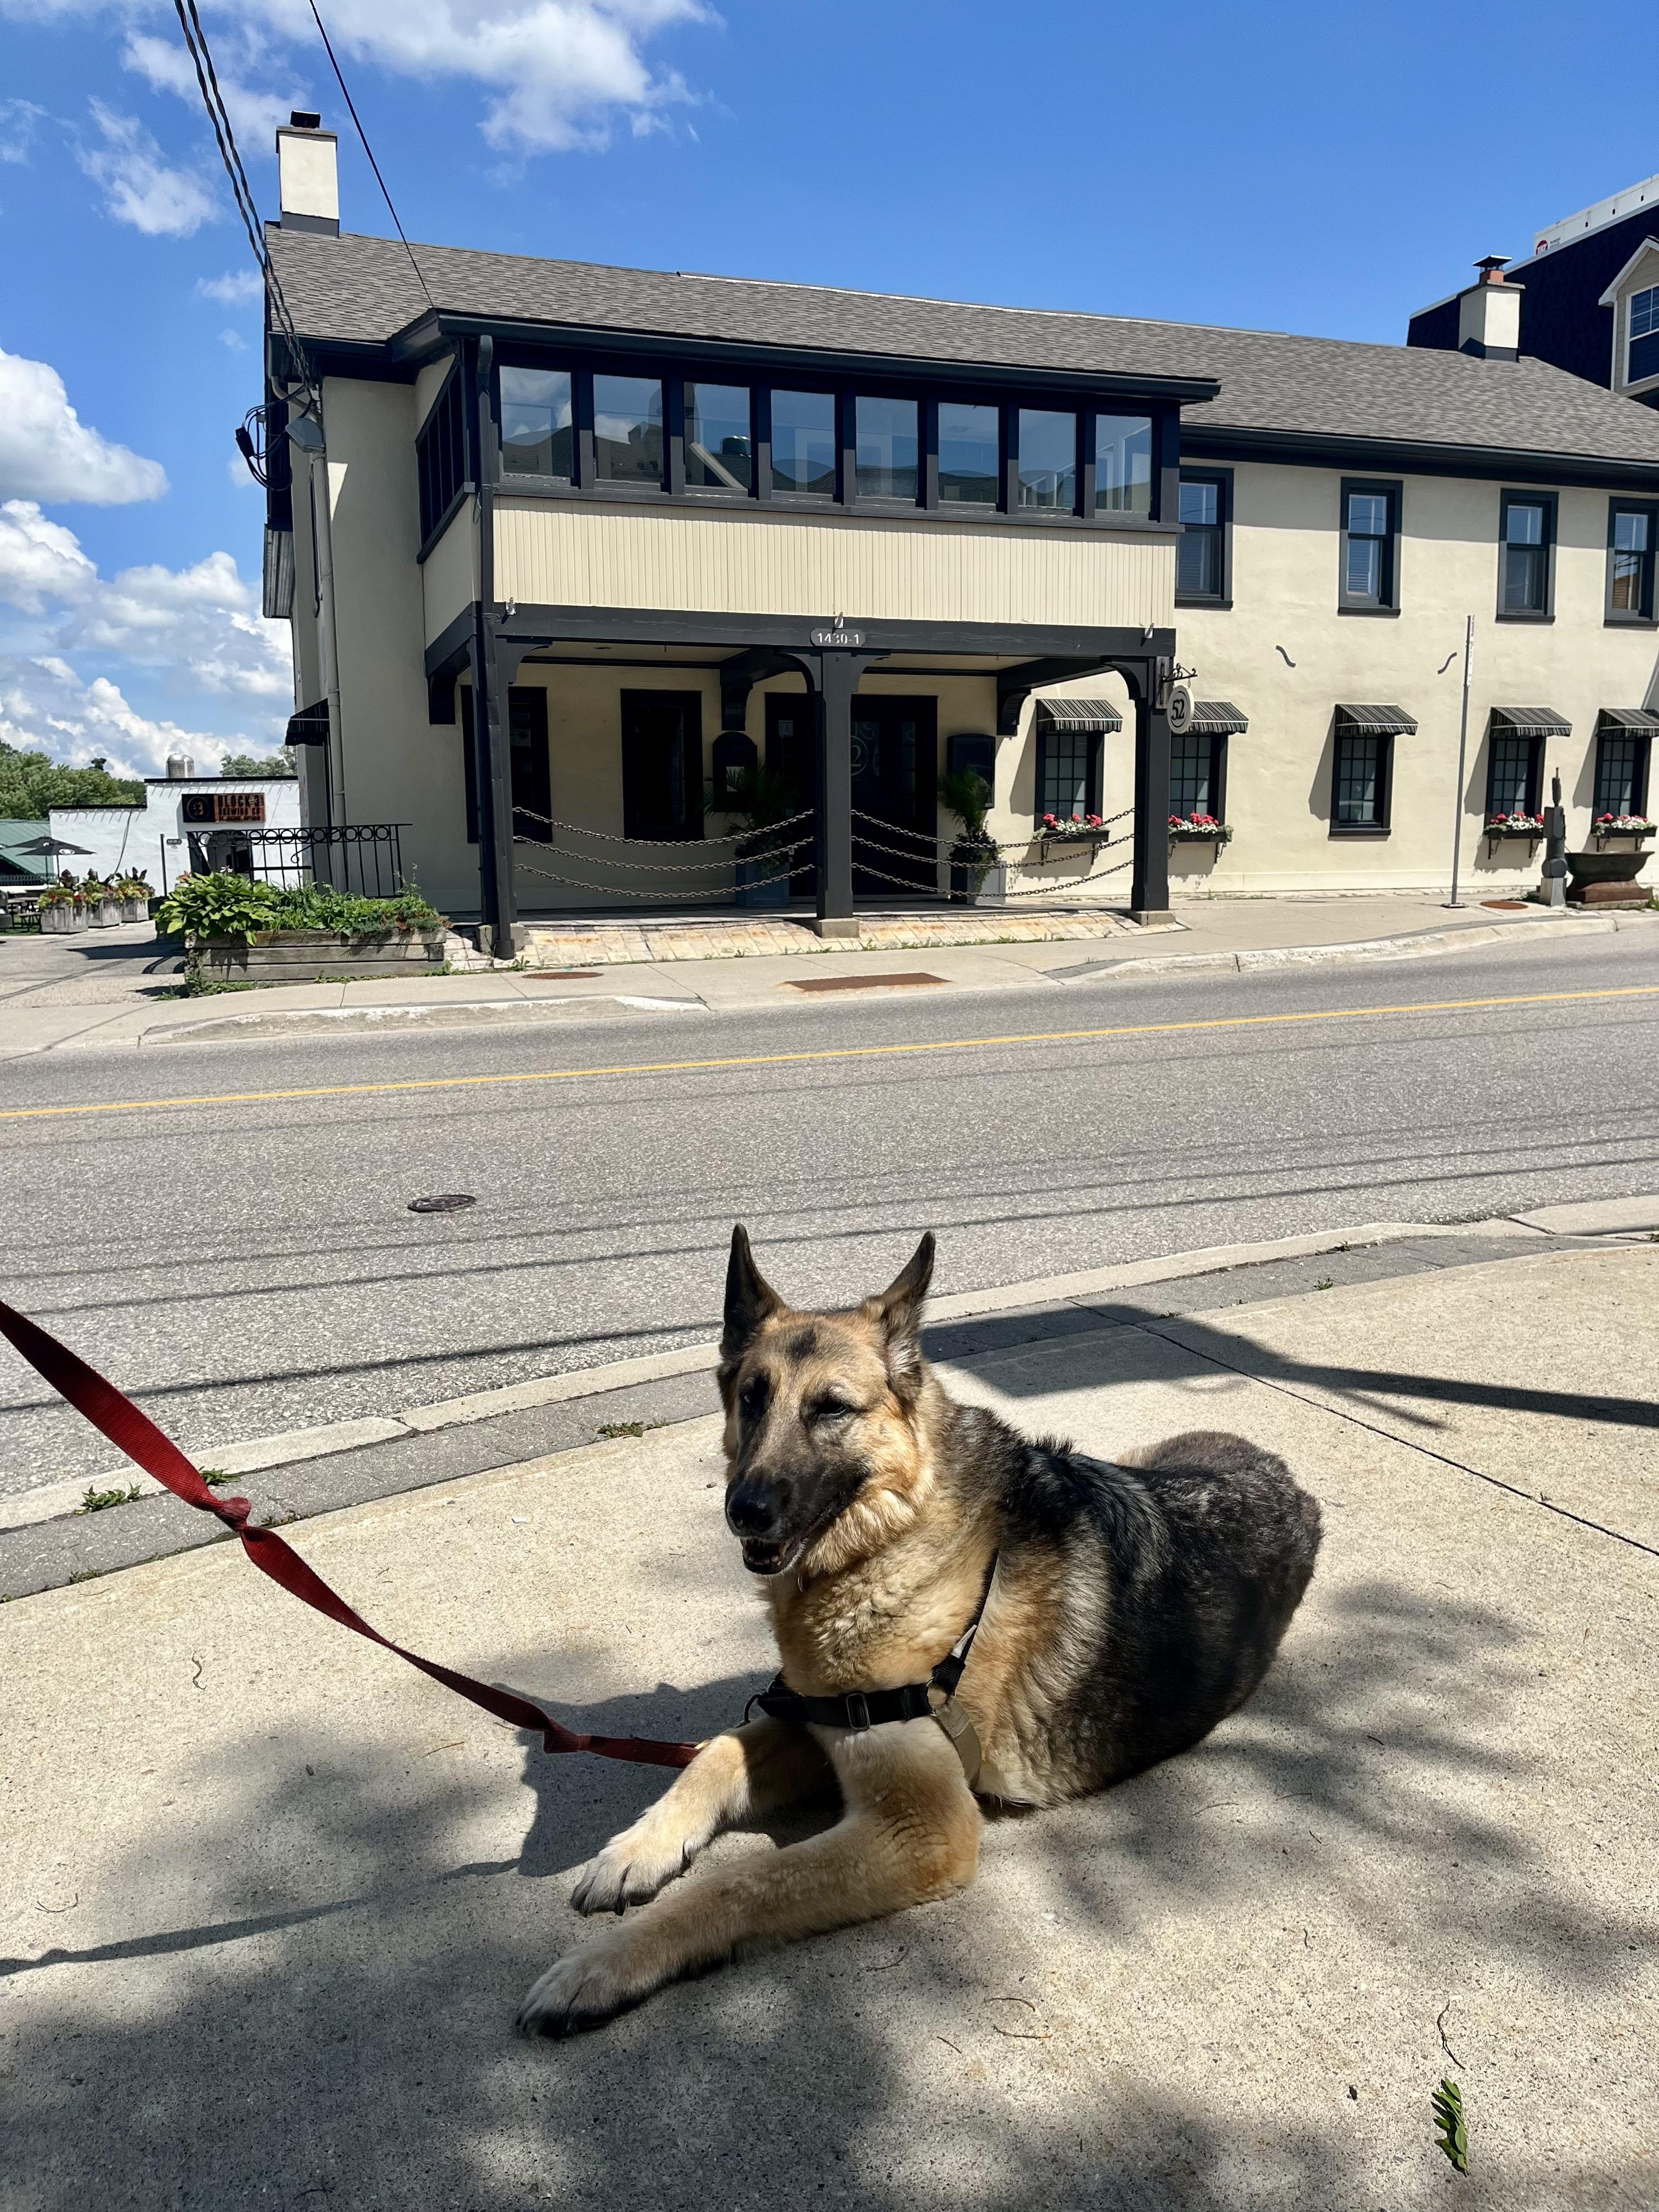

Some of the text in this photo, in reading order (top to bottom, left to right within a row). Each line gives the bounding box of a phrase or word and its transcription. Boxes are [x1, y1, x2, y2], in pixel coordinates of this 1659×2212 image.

[817, 633, 859, 644] 1430-1
[1171, 699, 1184, 720] 52
[218, 795, 250, 807] BLOCK
[219, 807, 248, 815] BREWING
